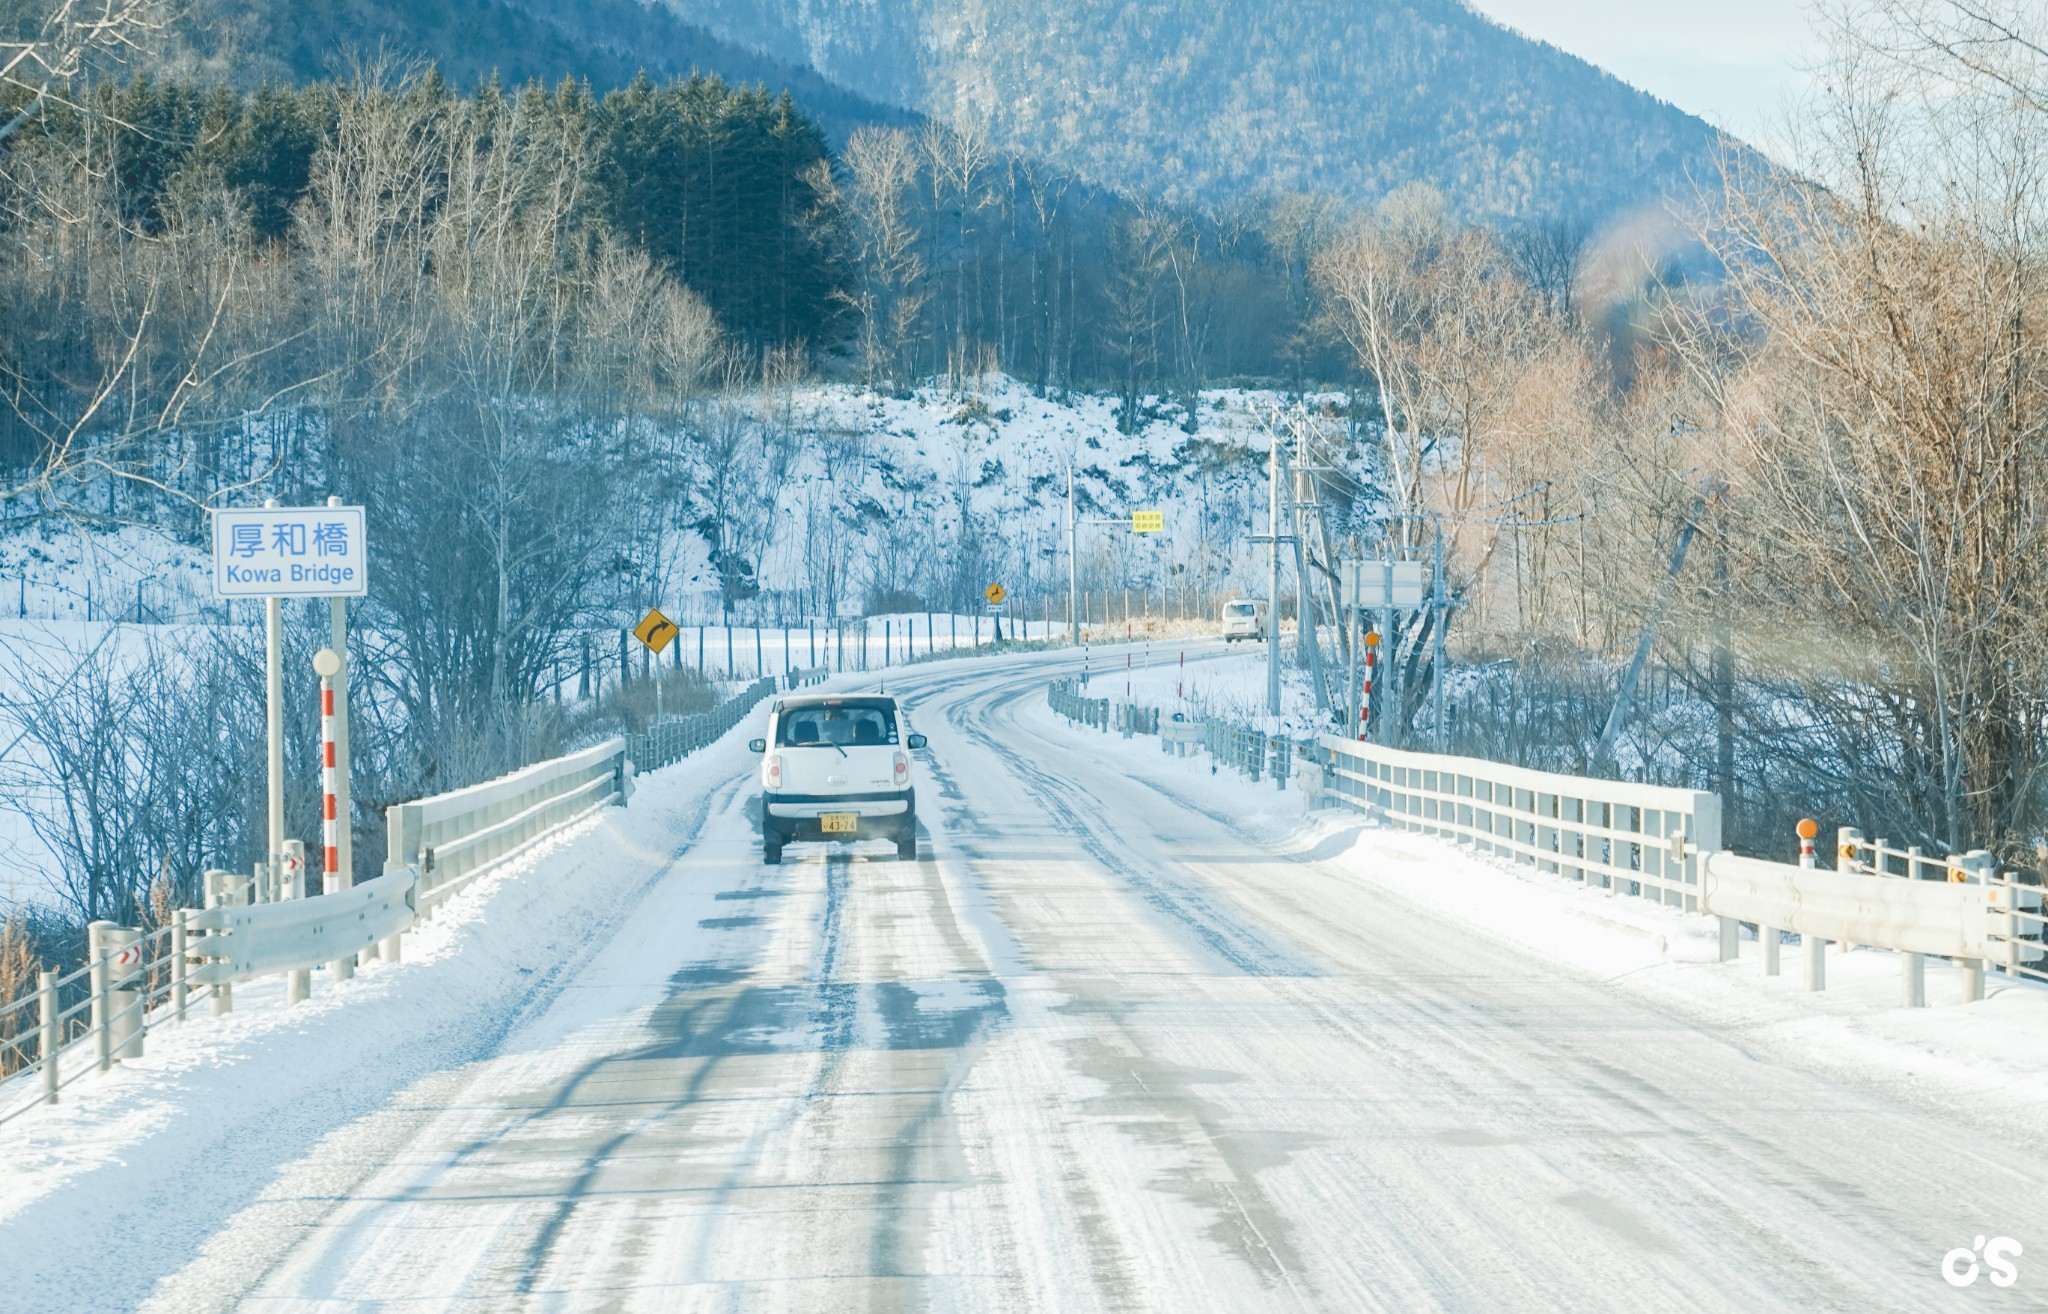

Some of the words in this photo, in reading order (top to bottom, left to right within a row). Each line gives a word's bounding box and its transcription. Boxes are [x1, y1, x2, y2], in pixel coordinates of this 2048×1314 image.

[230, 522, 349, 558] 厚和橋
[227, 564, 281, 583] Kowa
[291, 564, 354, 585] Bridge
[829, 821, 855, 831] 43-74
